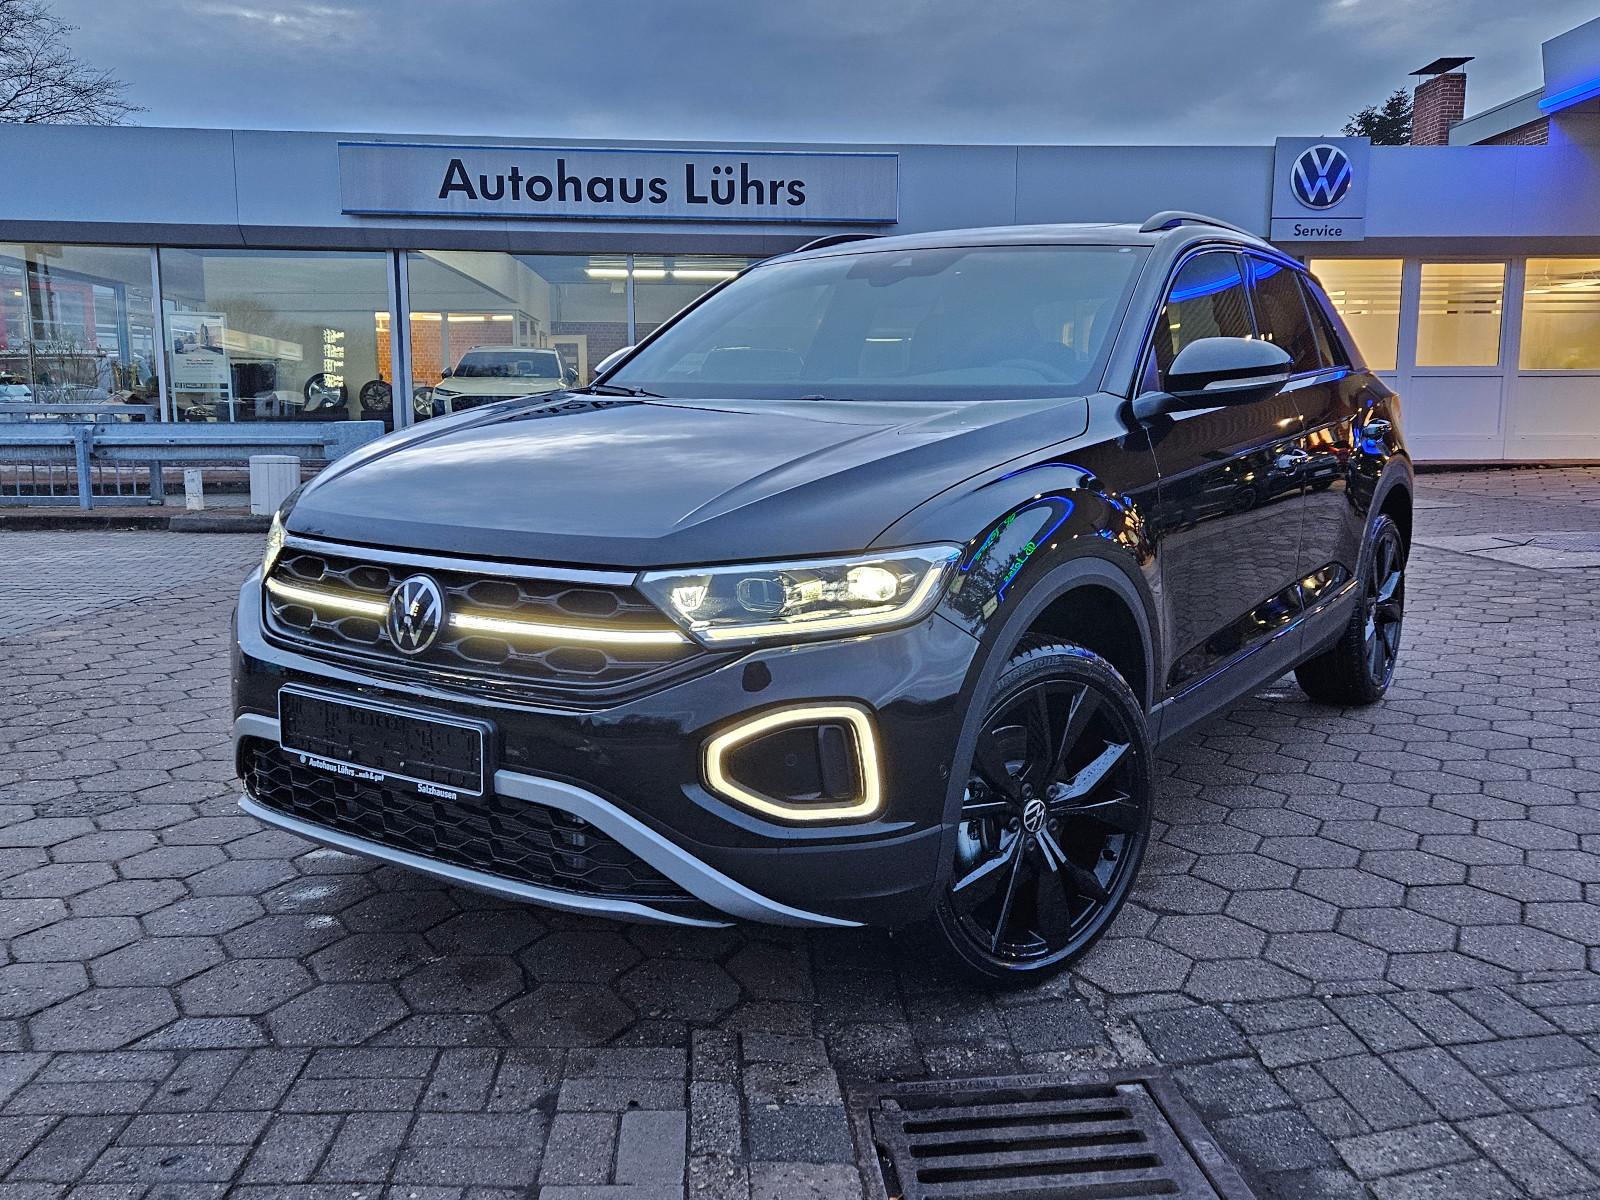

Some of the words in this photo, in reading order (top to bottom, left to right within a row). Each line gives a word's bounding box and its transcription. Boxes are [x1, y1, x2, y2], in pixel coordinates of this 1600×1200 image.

[438, 158, 668, 204] Autohaus
[685, 161, 806, 206] Lührs
[1293, 223, 1343, 237] Service
[308, 757, 338, 773] Autohaus
[337, 764, 355, 777] Lührs
[417, 782, 457, 801] Salzhausen
